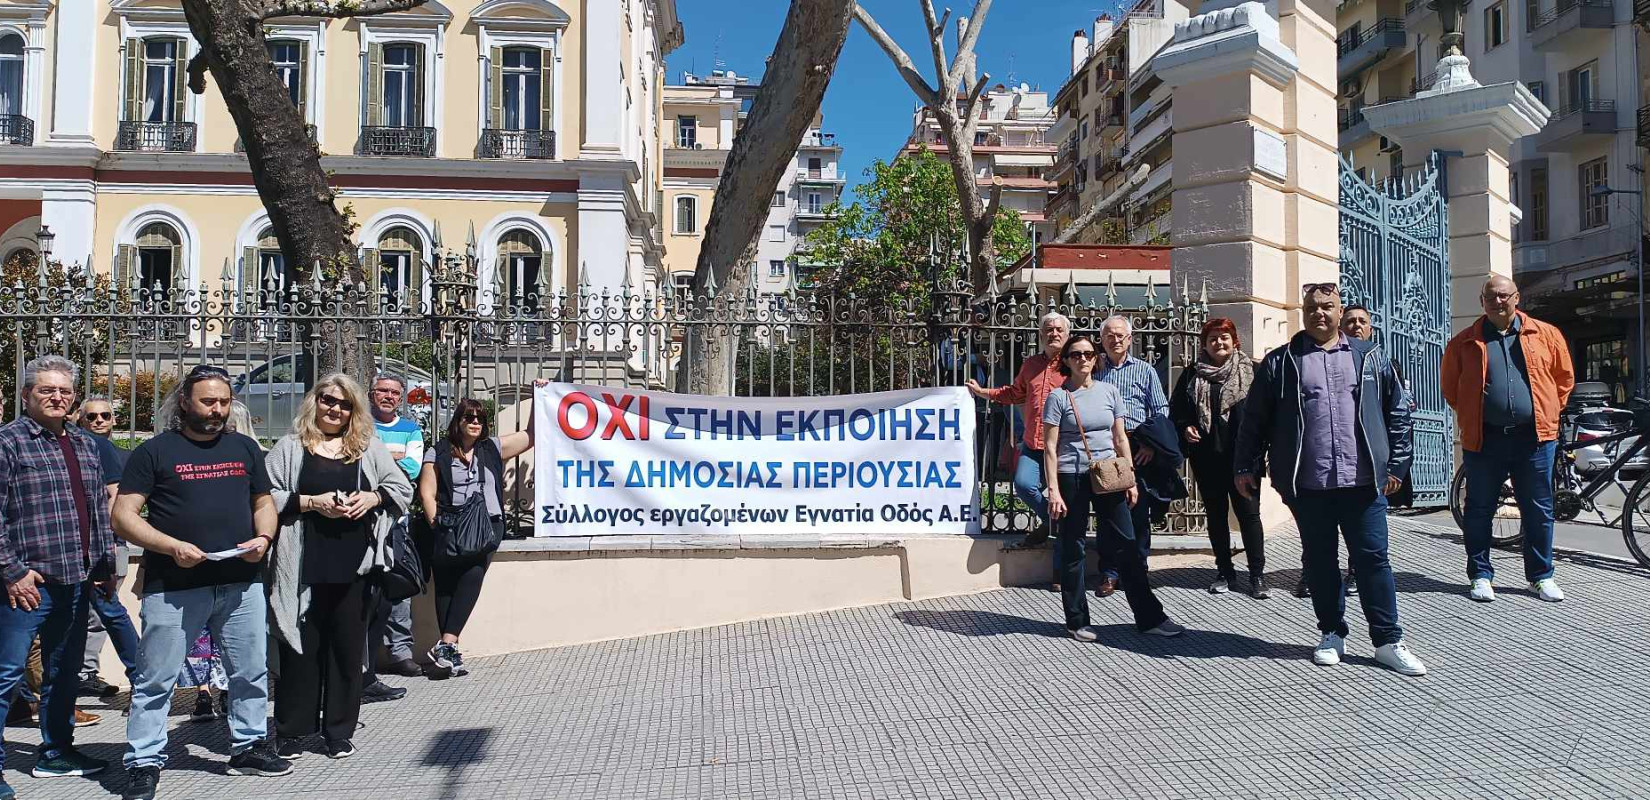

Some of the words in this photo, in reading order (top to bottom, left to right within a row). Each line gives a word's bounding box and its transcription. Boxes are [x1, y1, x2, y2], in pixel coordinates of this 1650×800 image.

[557, 391, 649, 440] ΟΧΙ
[665, 407, 761, 440] ΣΤΗΝ
[776, 408, 960, 441] ΕΚΠΟΙΗΣΗ
[557, 460, 614, 488] ΤΗΣ
[625, 460, 782, 488] ΔΗΜΟΣΙΑΣ
[793, 460, 962, 488] ΠΕΡΙΟΥΣΙΑΣ
[541, 503, 645, 526] Σύλλογος
[650, 503, 788, 526] εργαζομένων
[795, 503, 874, 526] Εγνατία
[880, 502, 933, 526] Οδός
[938, 504, 977, 522] Α.Ε.
